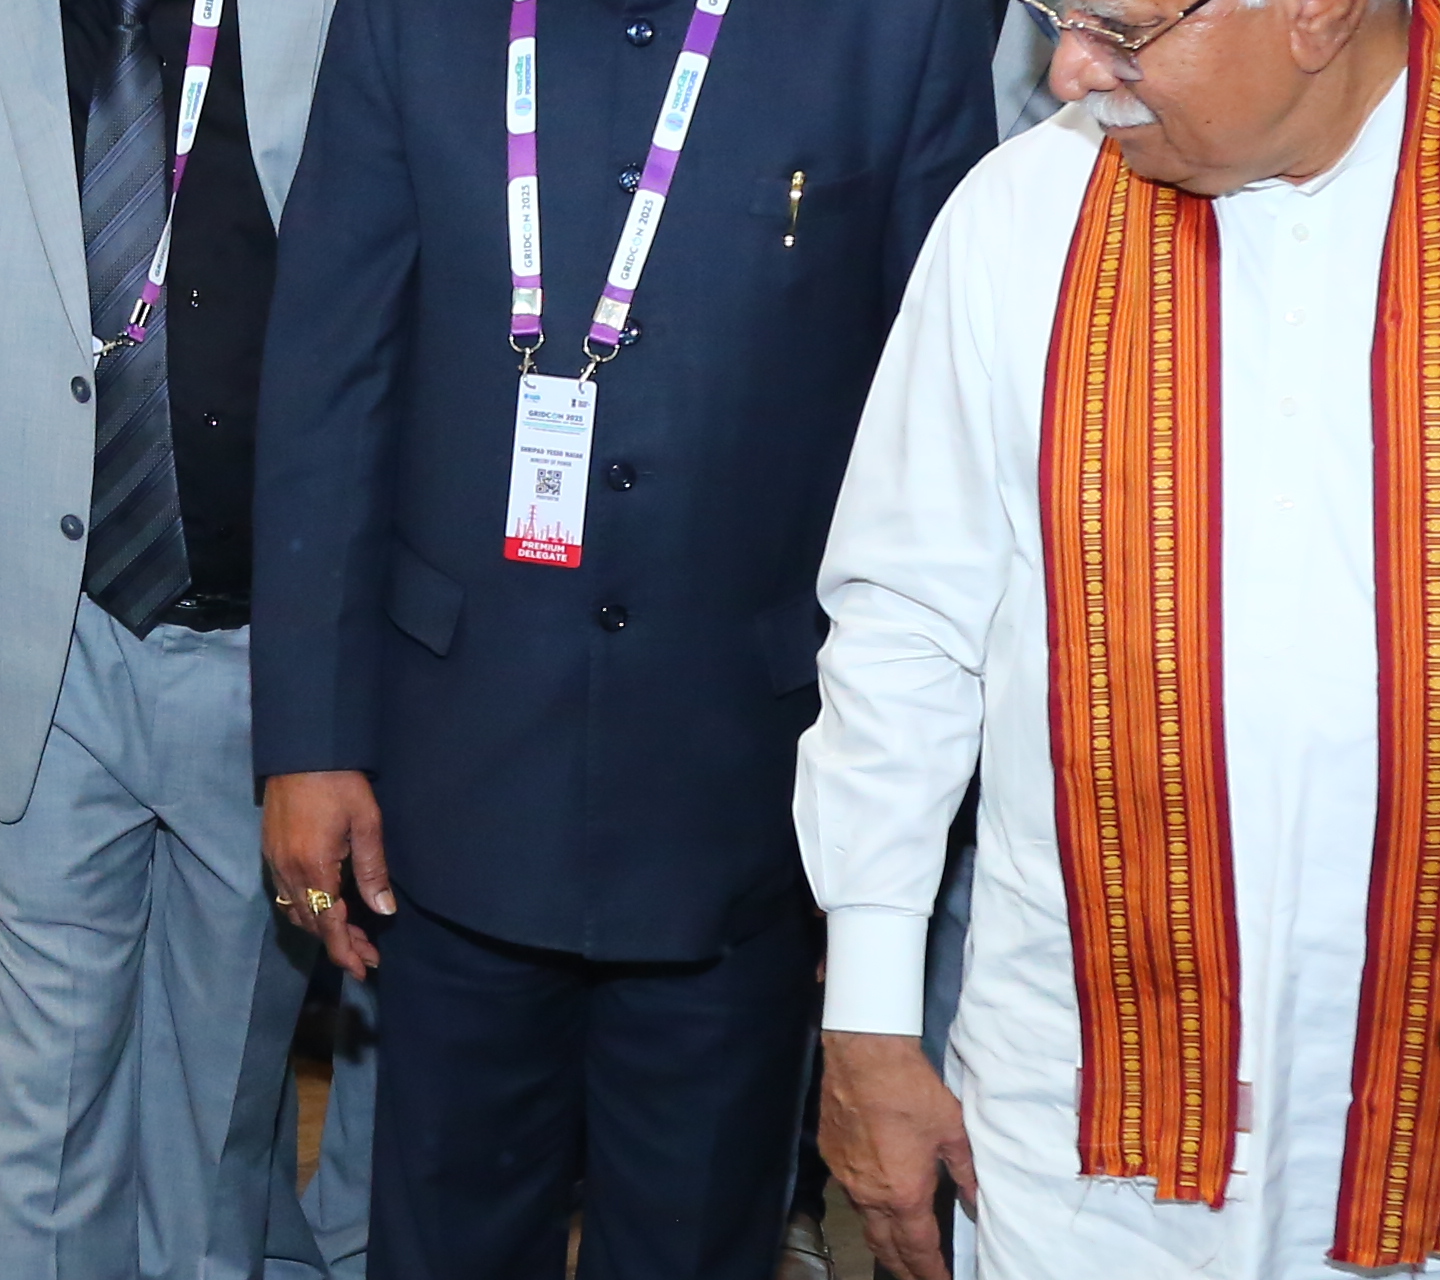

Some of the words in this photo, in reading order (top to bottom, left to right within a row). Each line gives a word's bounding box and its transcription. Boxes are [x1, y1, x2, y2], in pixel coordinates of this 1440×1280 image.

[521, 184, 530, 209] 2025
[523, 214, 532, 268] GRIDCON
[620, 228, 644, 281] GRIDCON
[638, 199, 654, 225] 2025
[518, 549, 568, 562] DELEGATE
[522, 541, 566, 553] PREMIUM
